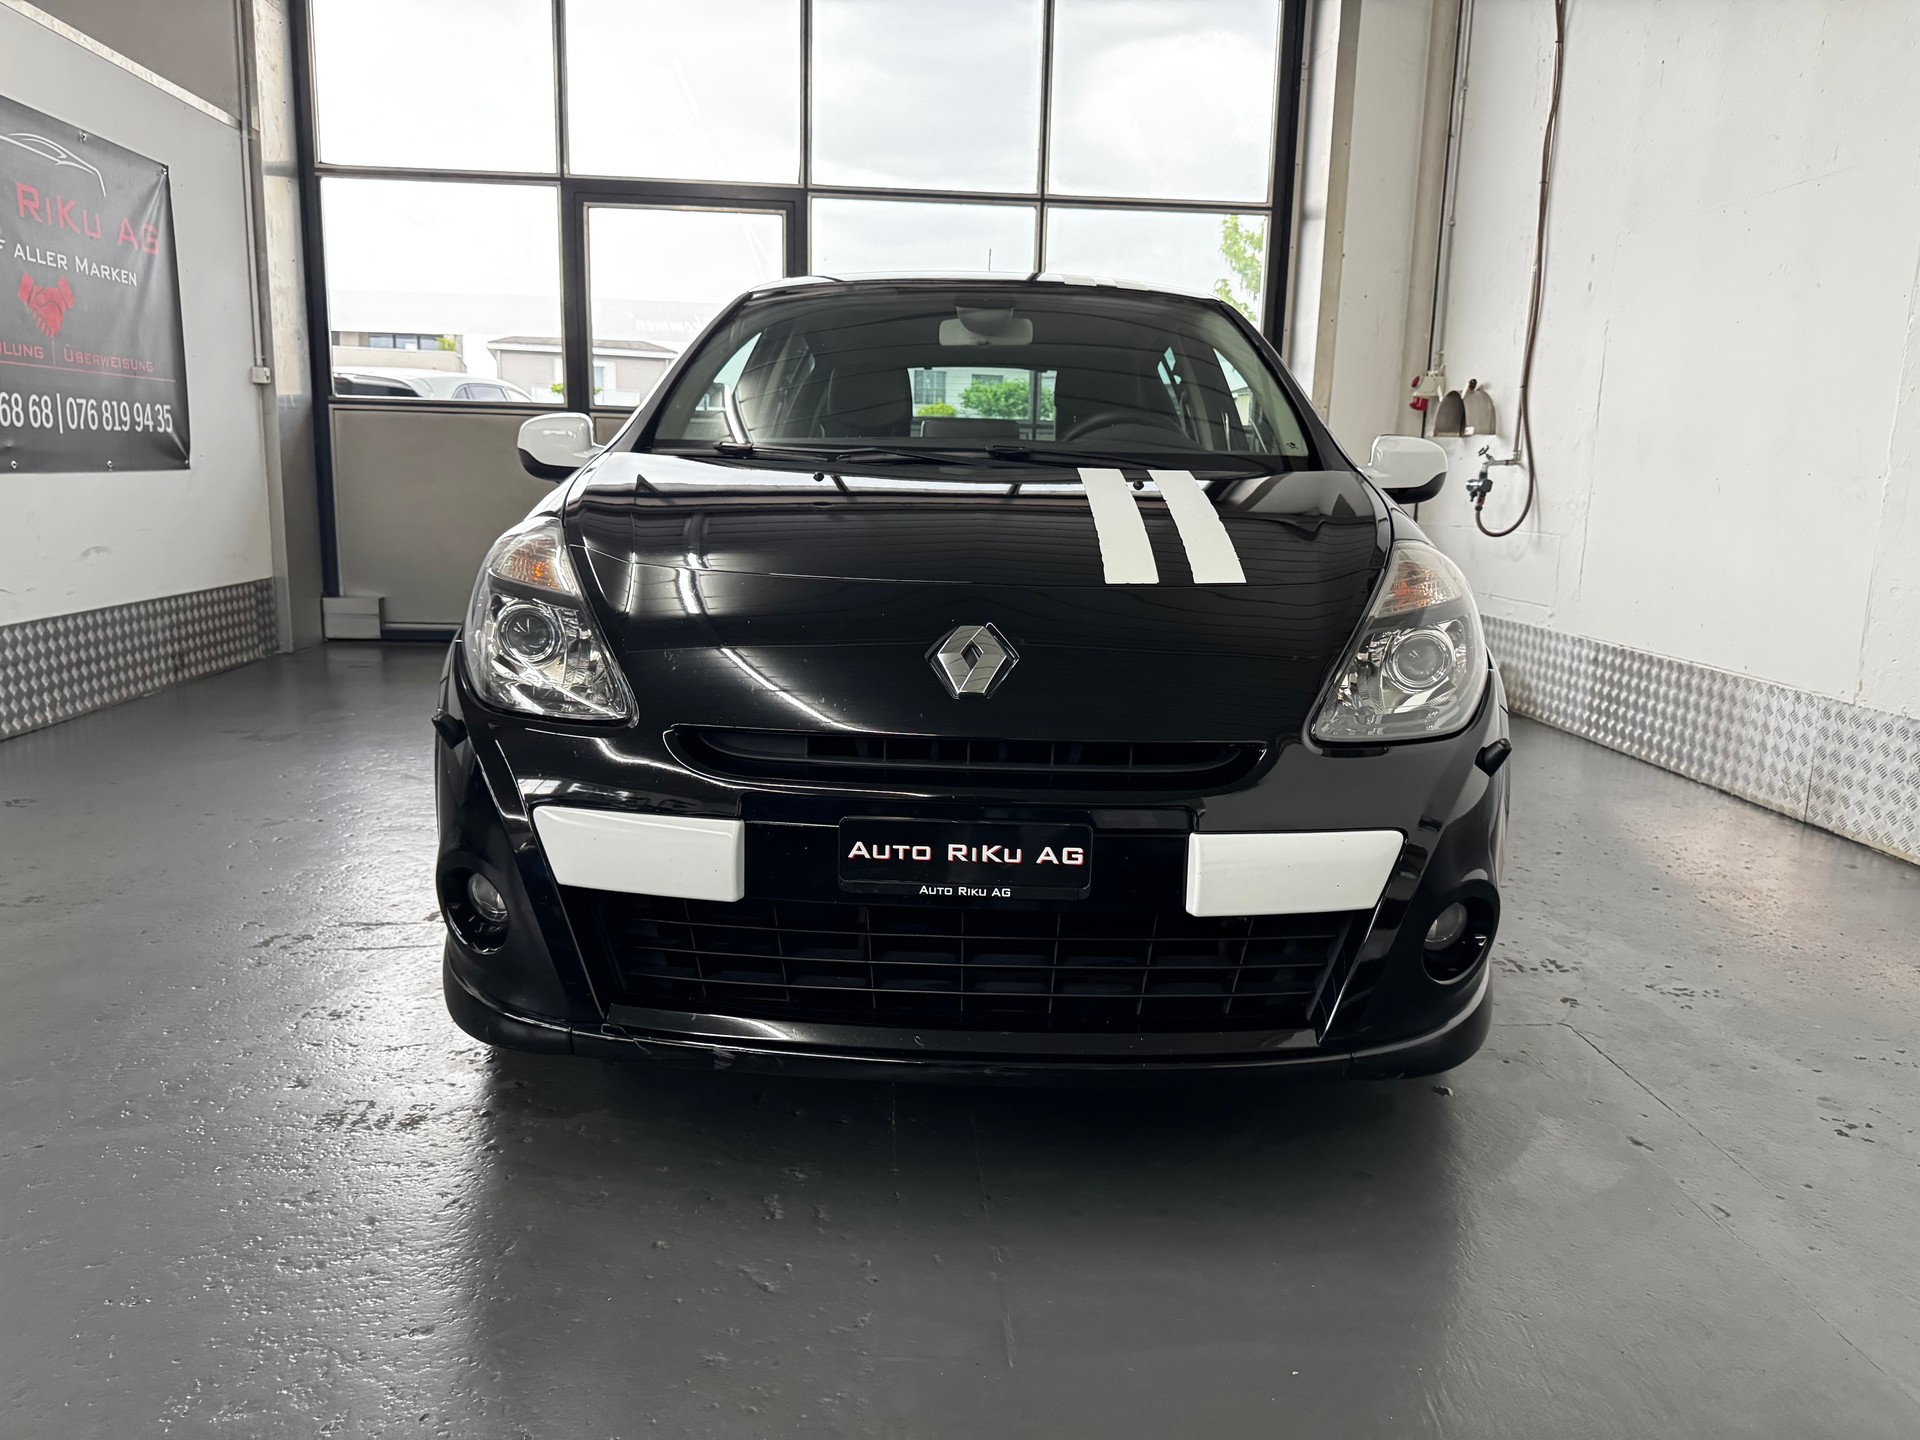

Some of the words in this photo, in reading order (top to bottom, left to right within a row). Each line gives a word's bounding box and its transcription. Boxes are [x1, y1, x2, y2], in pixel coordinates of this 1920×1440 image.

[118, 217, 158, 256] AG
[14, 243, 68, 270] ALLER
[0, 341, 44, 359] LUNG
[63, 343, 154, 372] ÜBERWEISUNG
[0, 391, 24, 428] 68
[29, 394, 53, 429] 68
[66, 397, 98, 430] 076
[102, 400, 130, 432] 819
[134, 402, 153, 432] 94
[155, 404, 173, 433] 35
[1036, 846, 1085, 866] AG
[991, 887, 1012, 898] AG
